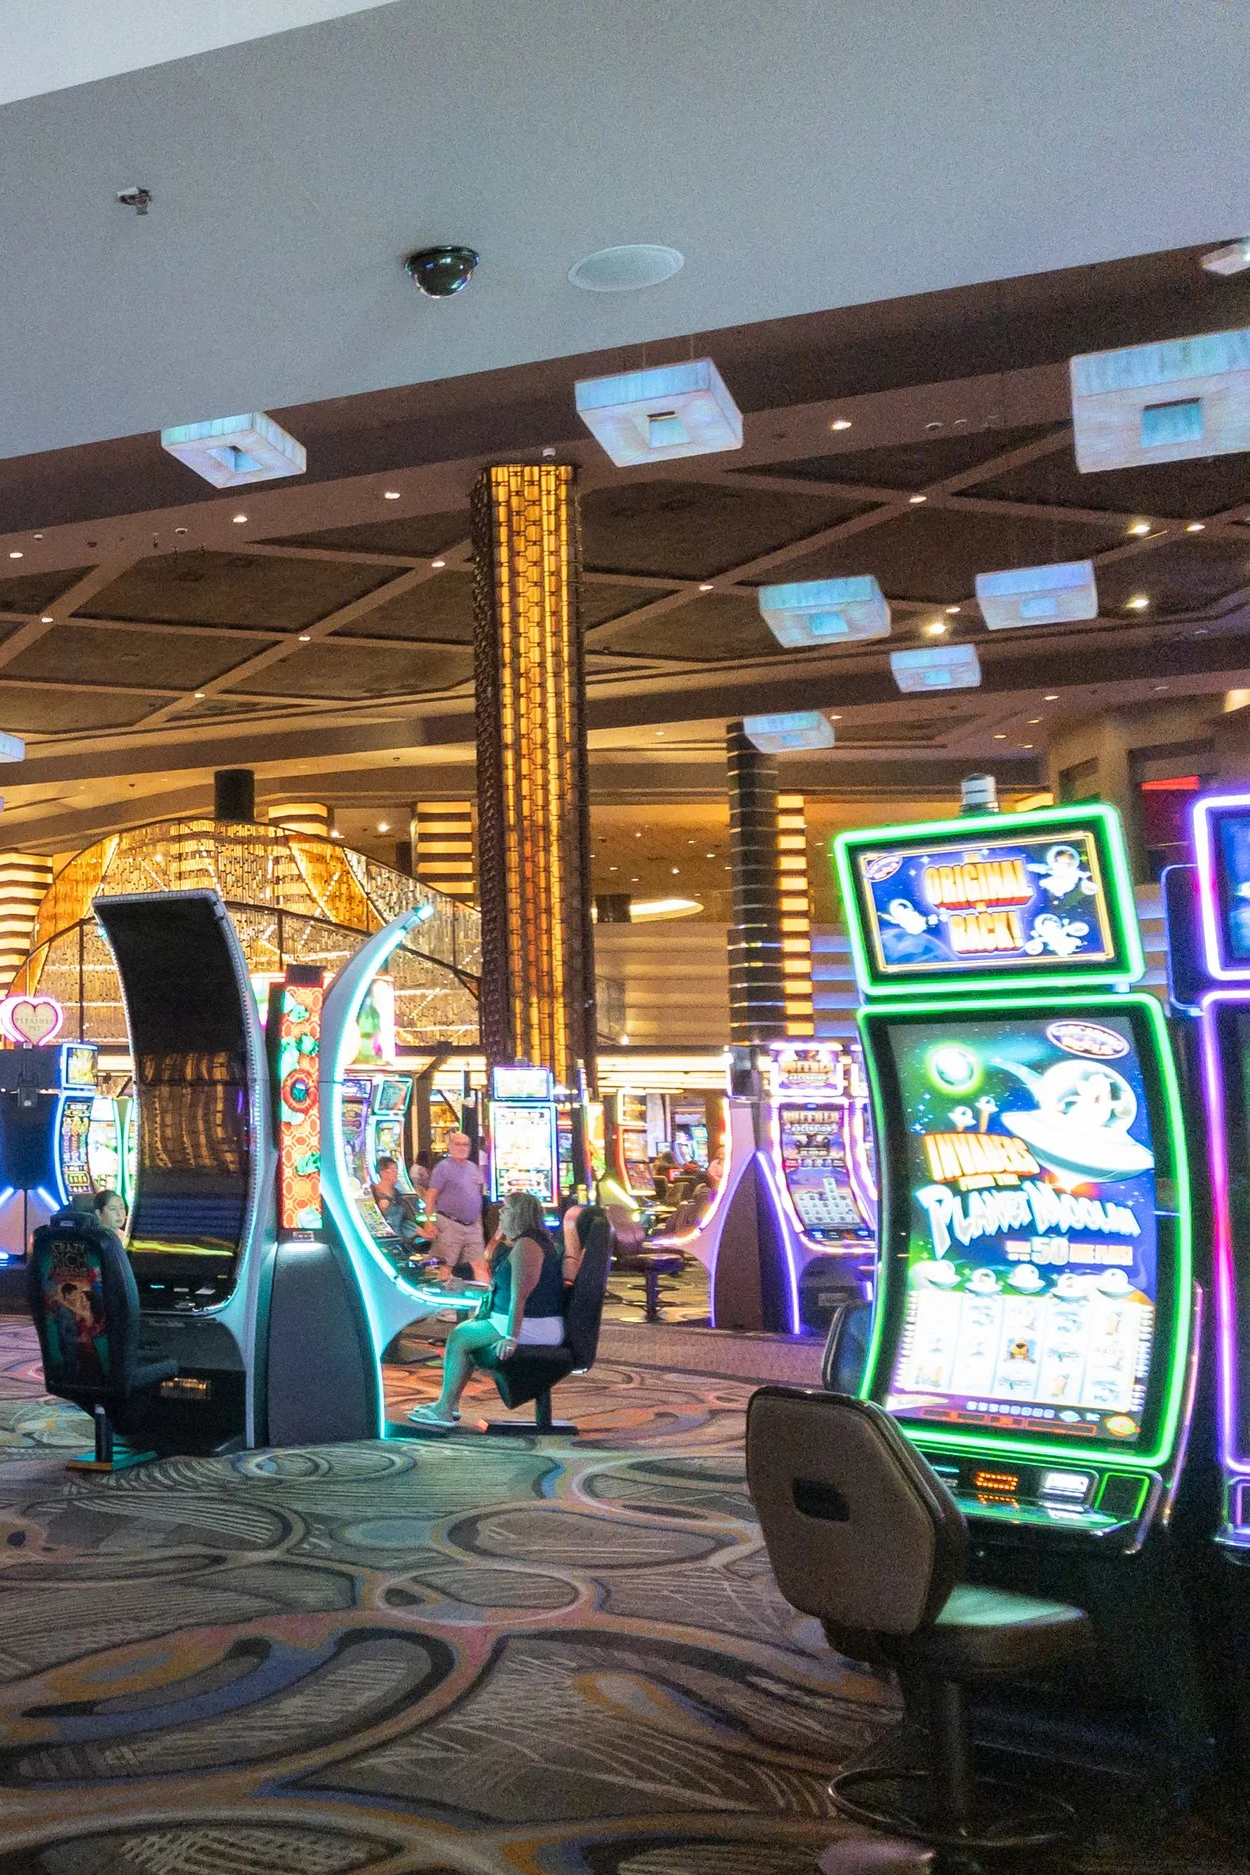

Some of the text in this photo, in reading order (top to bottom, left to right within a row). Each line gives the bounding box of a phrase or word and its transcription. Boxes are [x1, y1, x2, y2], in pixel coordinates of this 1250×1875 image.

[924, 858, 1034, 910] ORIGINAL
[949, 910, 1025, 954] BACK!
[914, 1184, 1032, 1260] PLANET
[53, 1242, 86, 1252] CRAZY
[1031, 1236, 1069, 1265] 50
